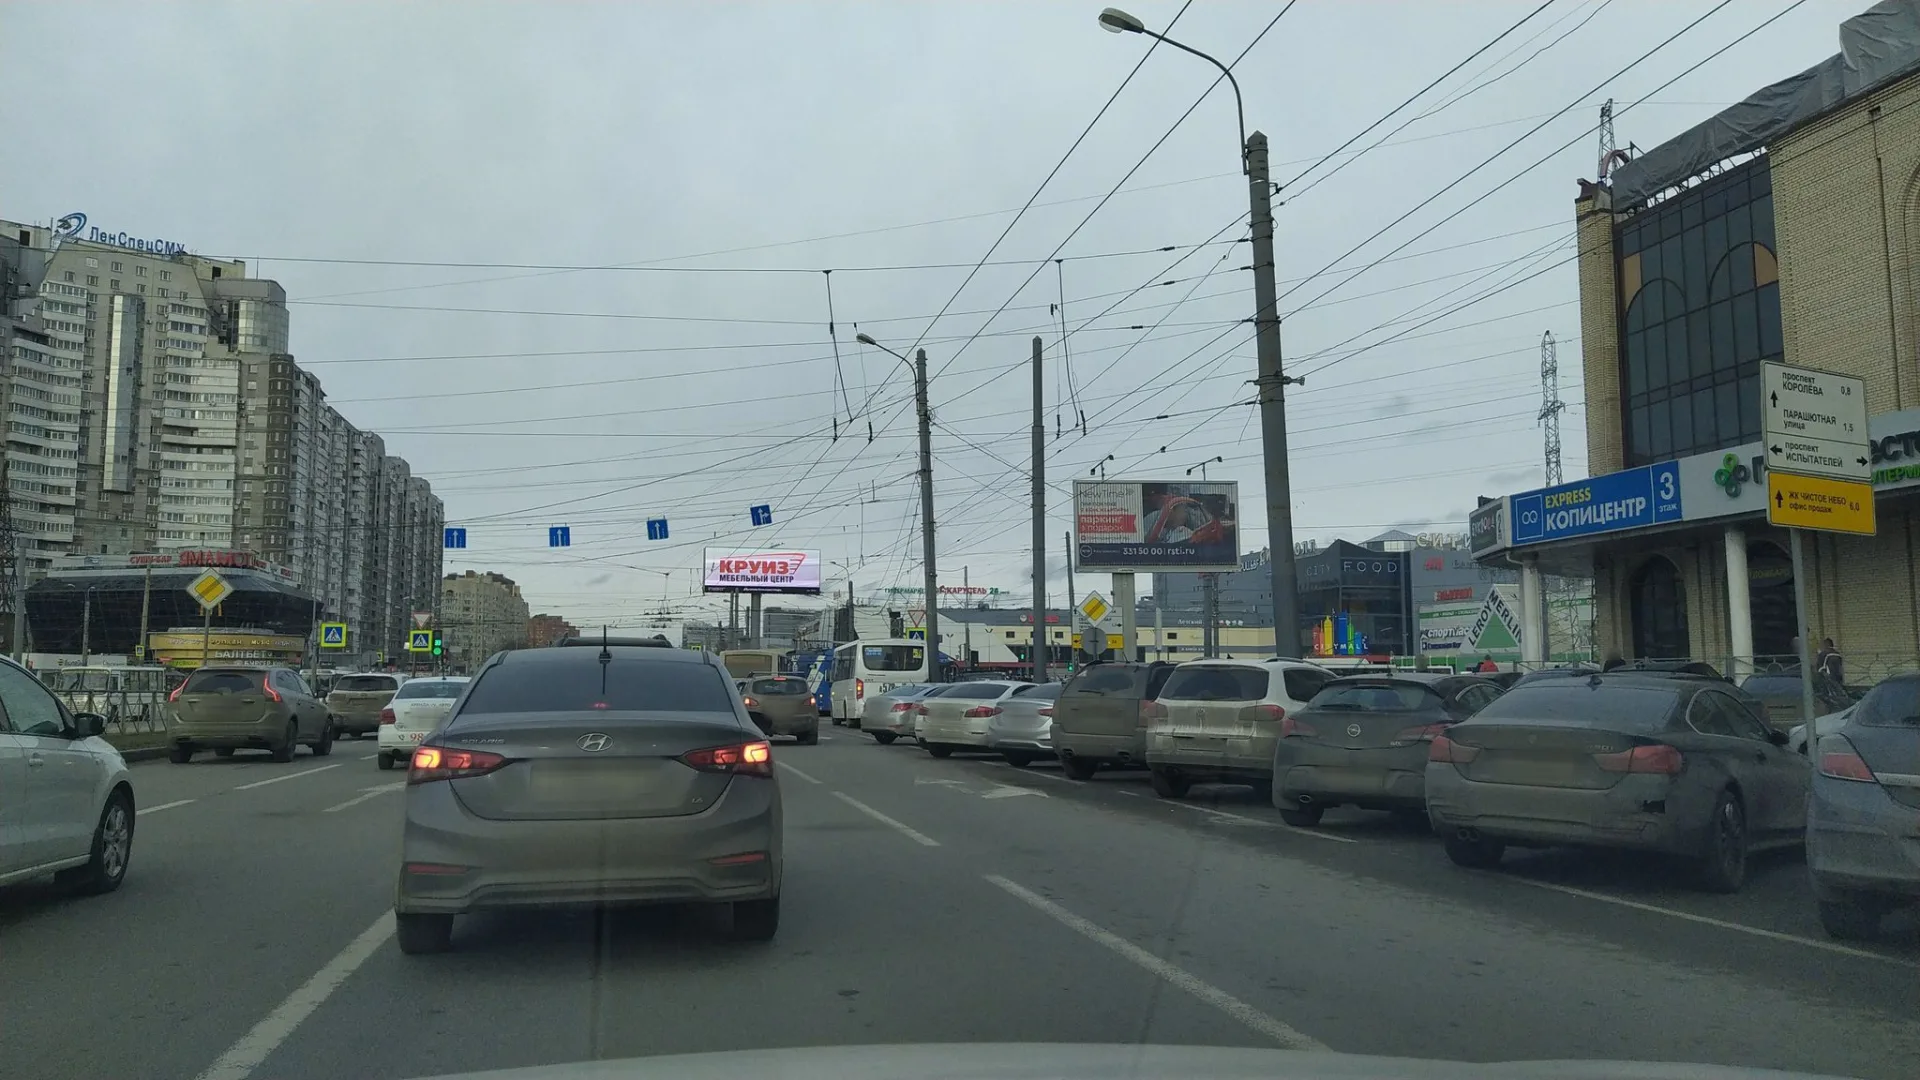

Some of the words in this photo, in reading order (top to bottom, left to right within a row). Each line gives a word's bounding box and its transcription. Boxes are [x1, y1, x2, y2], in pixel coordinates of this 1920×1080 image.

[89, 227, 185, 254] ЛенСпецСМУ
[1782, 372, 1816, 384] проспект
[1840, 386, 1851, 397] 0,8
[1783, 409, 1837, 425] ПАРАШЮТНАЯ
[1783, 420, 1806, 431] улица
[1843, 423, 1854, 433] 1,5
[1784, 442, 1819, 453] проспект
[1785, 453, 1843, 468] ИСПЫТАТЕЛЕЙ
[1659, 471, 1675, 500] 3
[1545, 487, 1592, 509] EXPRESS
[1788, 491, 1799, 499] ЖК
[1800, 492, 1828, 503] ЧИСТОЕ
[1828, 494, 1847, 505] НЕБО
[1658, 502, 1678, 513] этаж
[1789, 502, 1808, 511] офис
[1808, 505, 1833, 513] продаж
[1546, 497, 1646, 532] КОПИЦЕНТР
[1167, 546, 1195, 555] rsti.ru
[720, 560, 789, 574] КРУИЗ
[1343, 561, 1399, 574] FOOD
[719, 574, 768, 582] МЕБЕЛЬНЫЙ
[1468, 601, 1492, 646] LEROY
